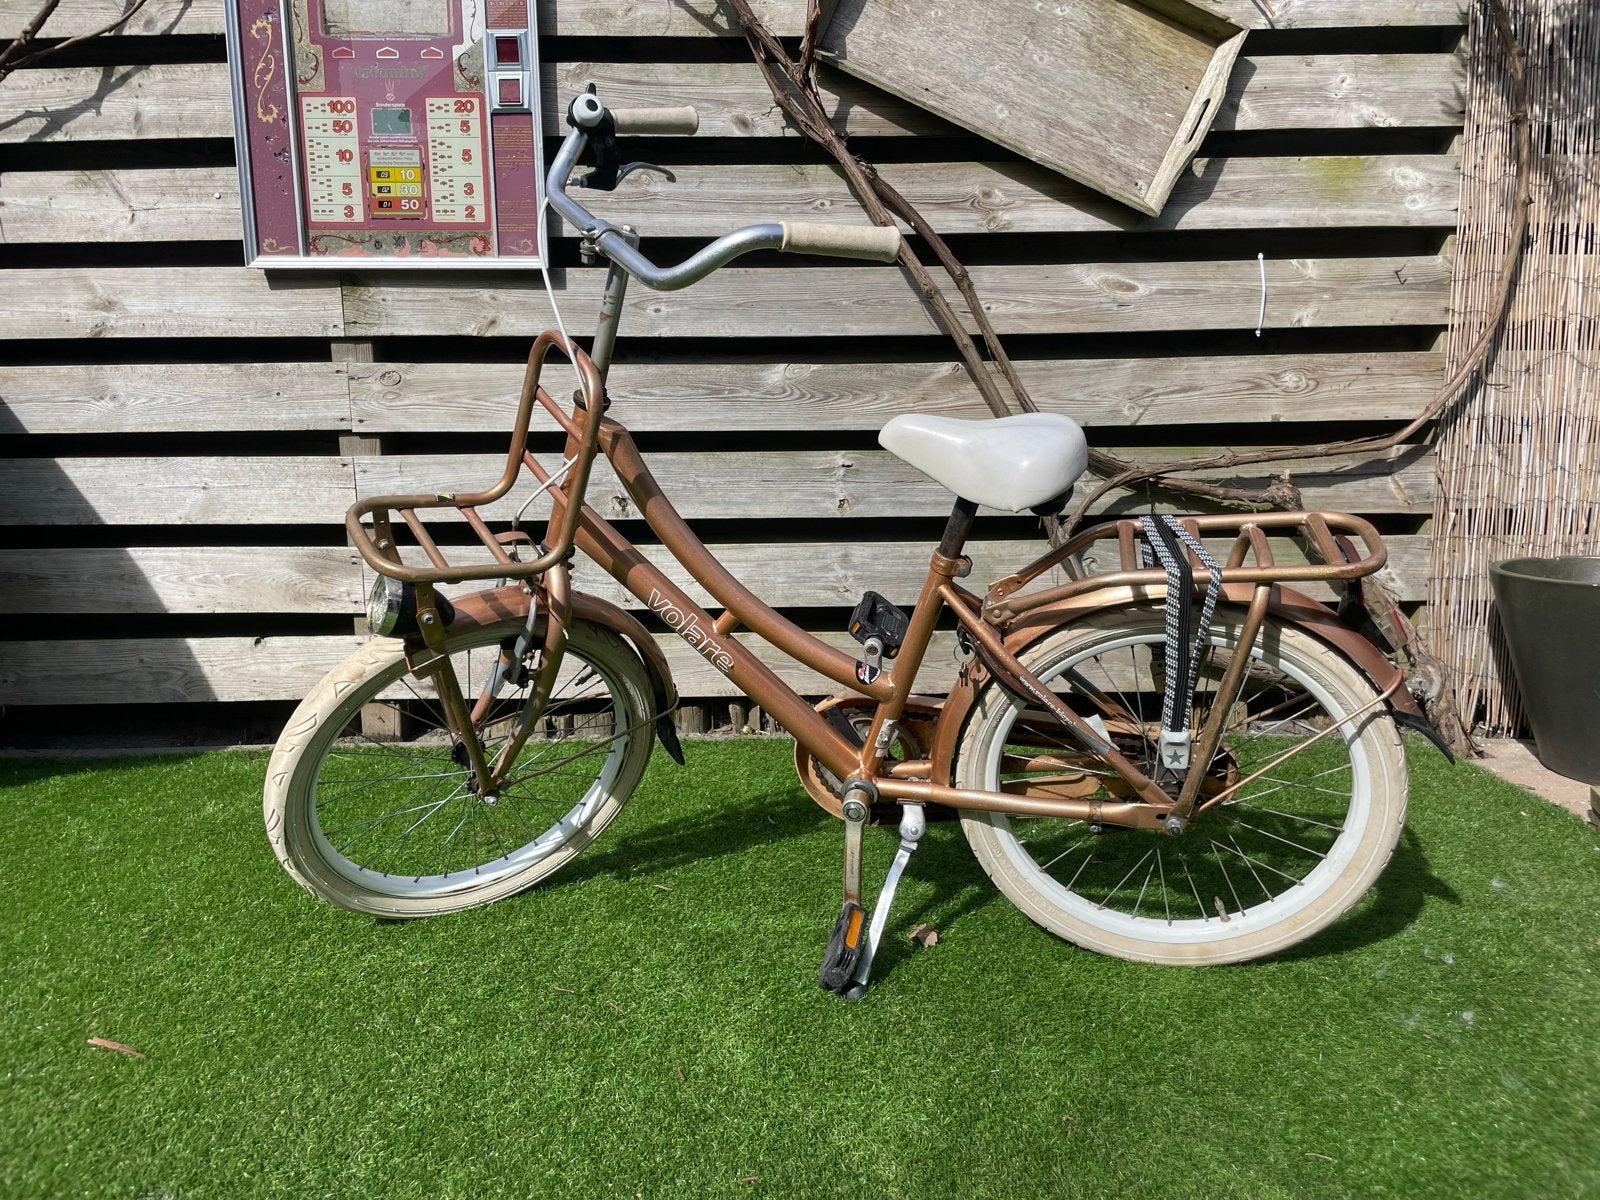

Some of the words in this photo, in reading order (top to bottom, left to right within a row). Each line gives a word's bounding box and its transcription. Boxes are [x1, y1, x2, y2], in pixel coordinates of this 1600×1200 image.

[327, 100, 355, 113] 100
[454, 99, 475, 113] 20
[332, 119, 354, 133] 50
[459, 119, 471, 133] 5
[336, 148, 354, 162] 10
[461, 148, 473, 162] 5
[400, 169, 415, 181] 10
[341, 182, 353, 196] 5
[400, 184, 418, 196] 30
[463, 182, 474, 196] 3
[343, 204, 355, 218] 3
[401, 199, 419, 210] 50
[464, 205, 476, 218] 2
[647, 587, 735, 673] volare
